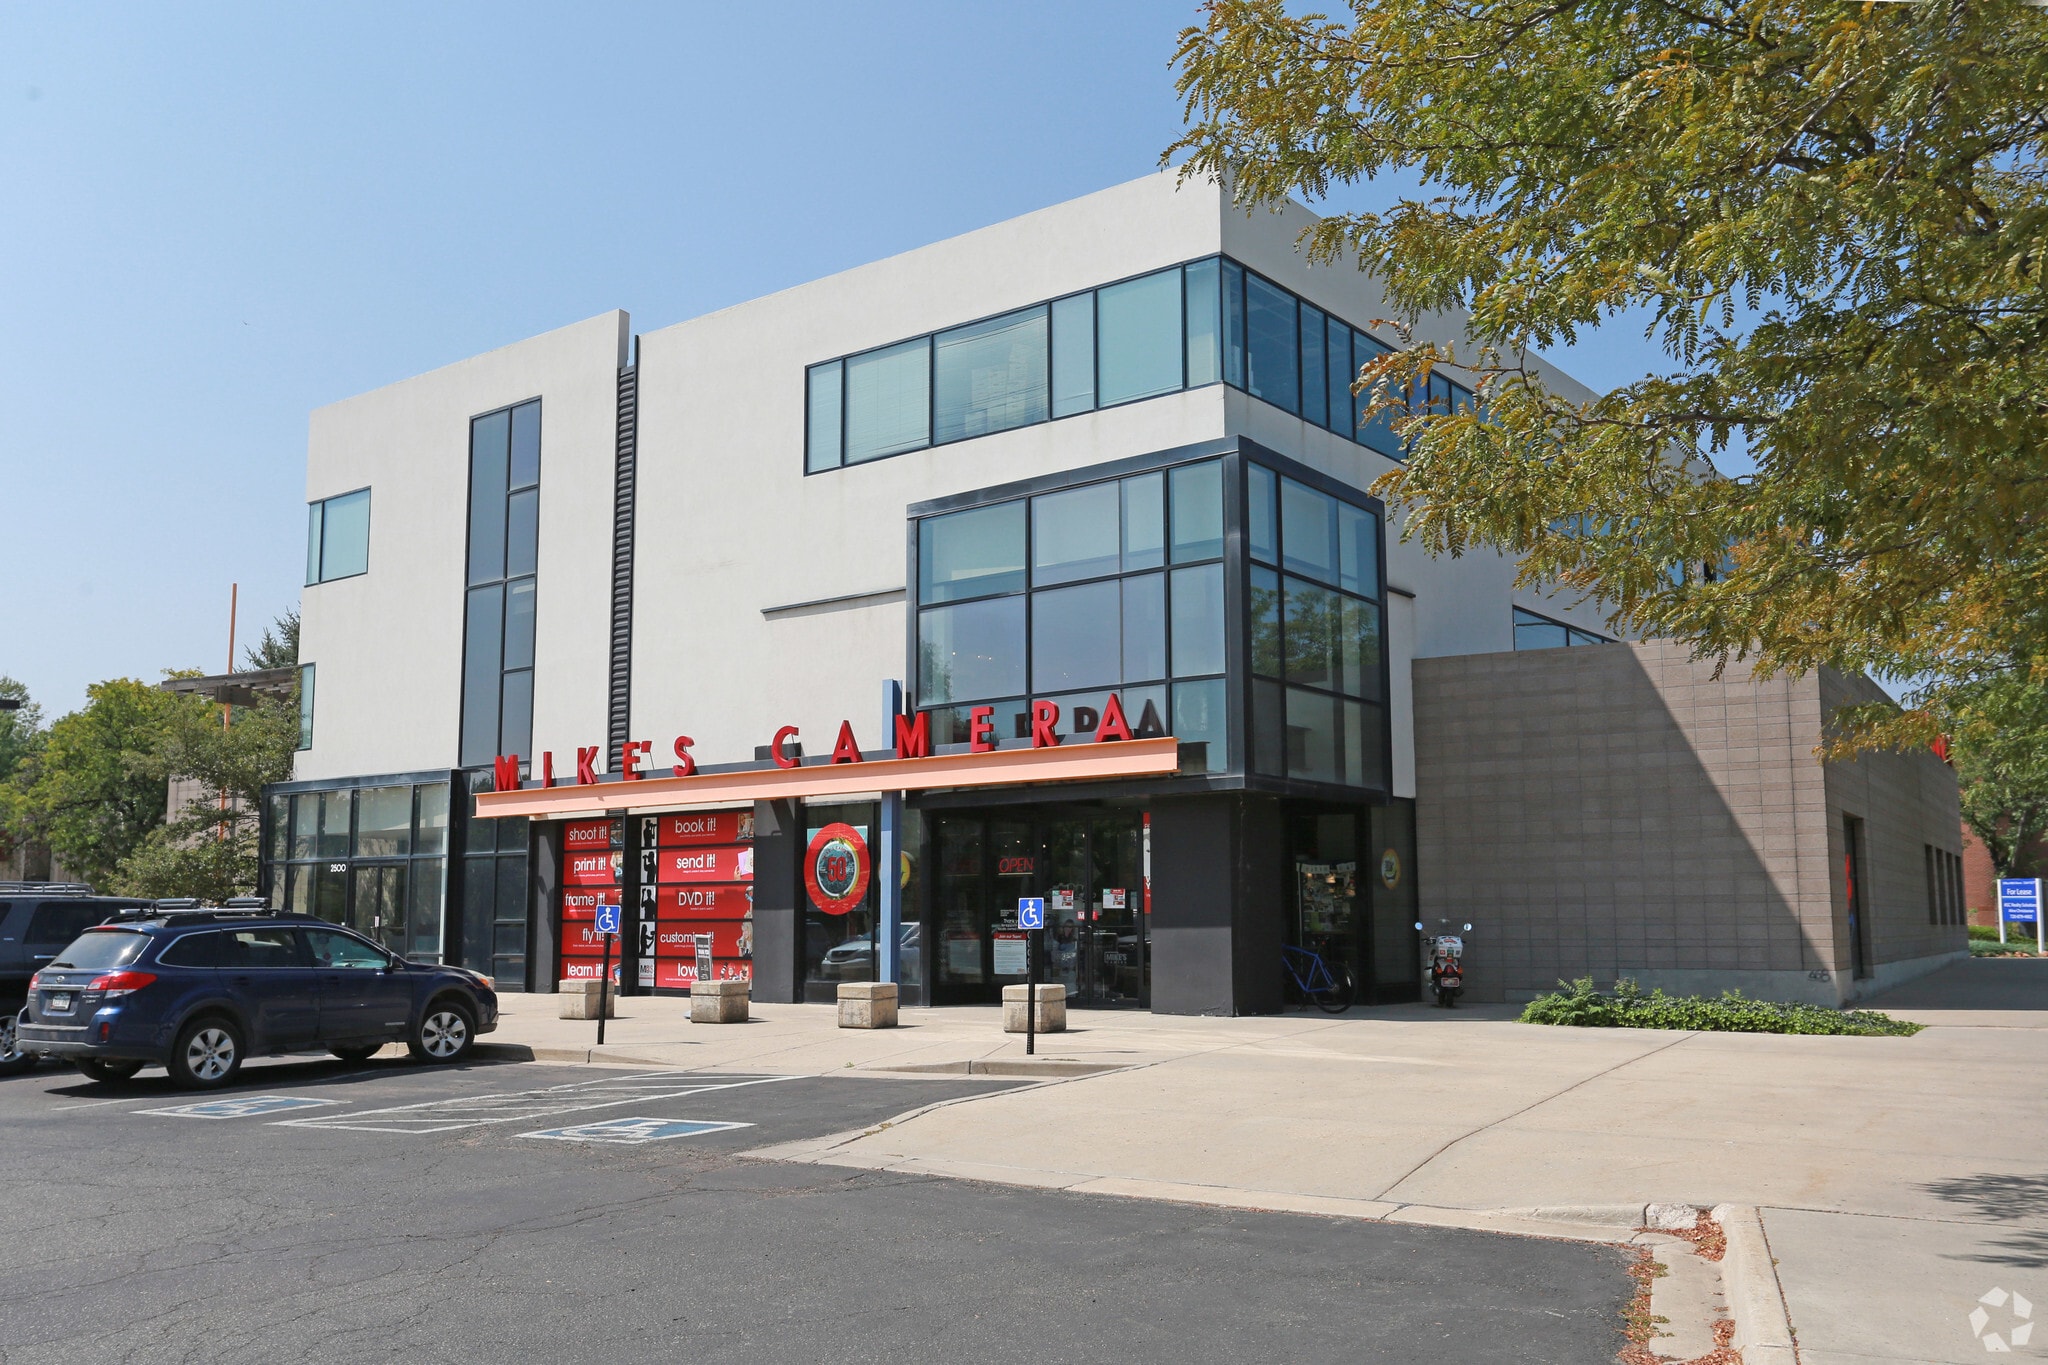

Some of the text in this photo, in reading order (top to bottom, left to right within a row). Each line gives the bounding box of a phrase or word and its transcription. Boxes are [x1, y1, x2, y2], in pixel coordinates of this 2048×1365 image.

[494, 692, 1134, 792] MIKE'S CAMERA
[675, 817, 716, 834] book it!
[569, 826, 607, 841] shoot it!
[330, 863, 347, 872] 2500
[573, 857, 606, 874] print it!
[676, 853, 716, 869] send it!
[998, 857, 1035, 873] OPEN
[827, 856, 847, 882] 50
[565, 892, 606, 906] frame it!
[678, 891, 715, 906] DVD it!
[2006, 888, 2033, 896] For Lease
[582, 928, 594, 944] fly
[660, 931, 697, 943] customi
[567, 962, 604, 977] learn it!
